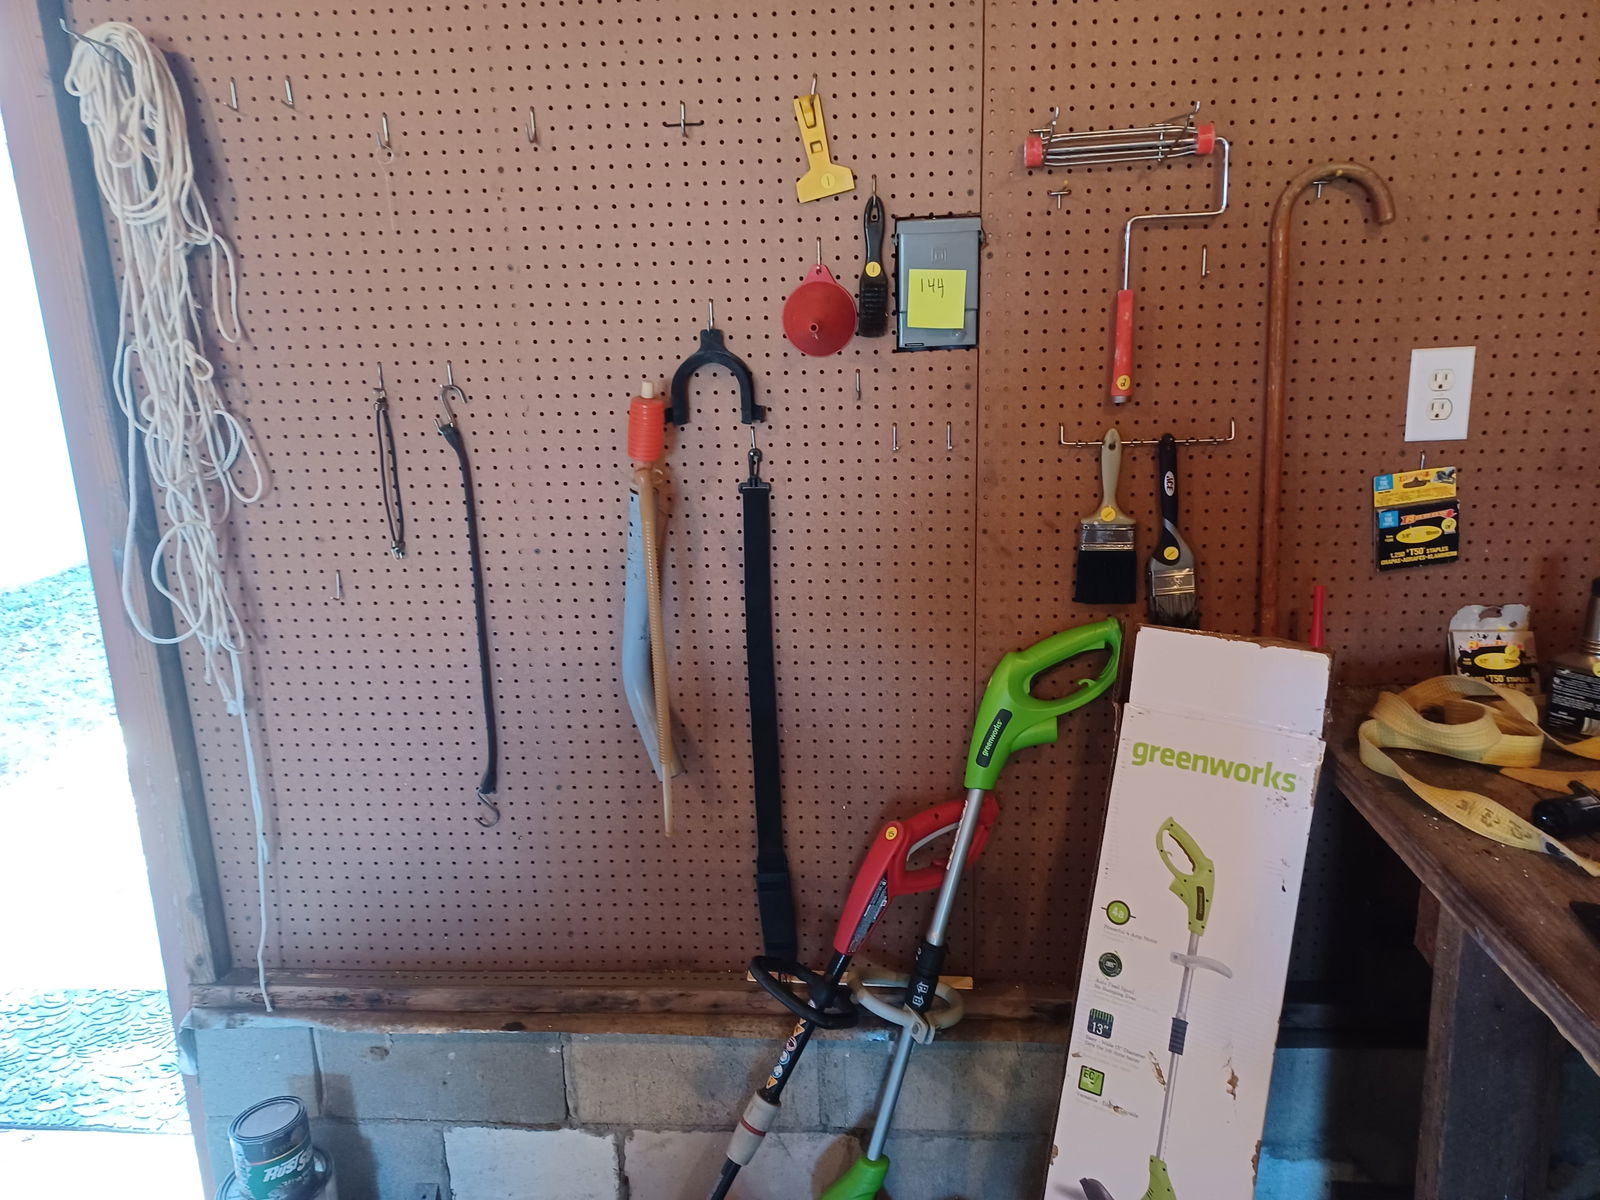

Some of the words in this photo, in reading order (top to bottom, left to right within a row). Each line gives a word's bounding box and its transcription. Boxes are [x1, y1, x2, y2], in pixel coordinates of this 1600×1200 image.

[920, 277, 945, 298] 144
[982, 719, 1003, 757] greenworks
[1132, 742, 1297, 793] greenworks
[1083, 1069, 1095, 1081] EC
